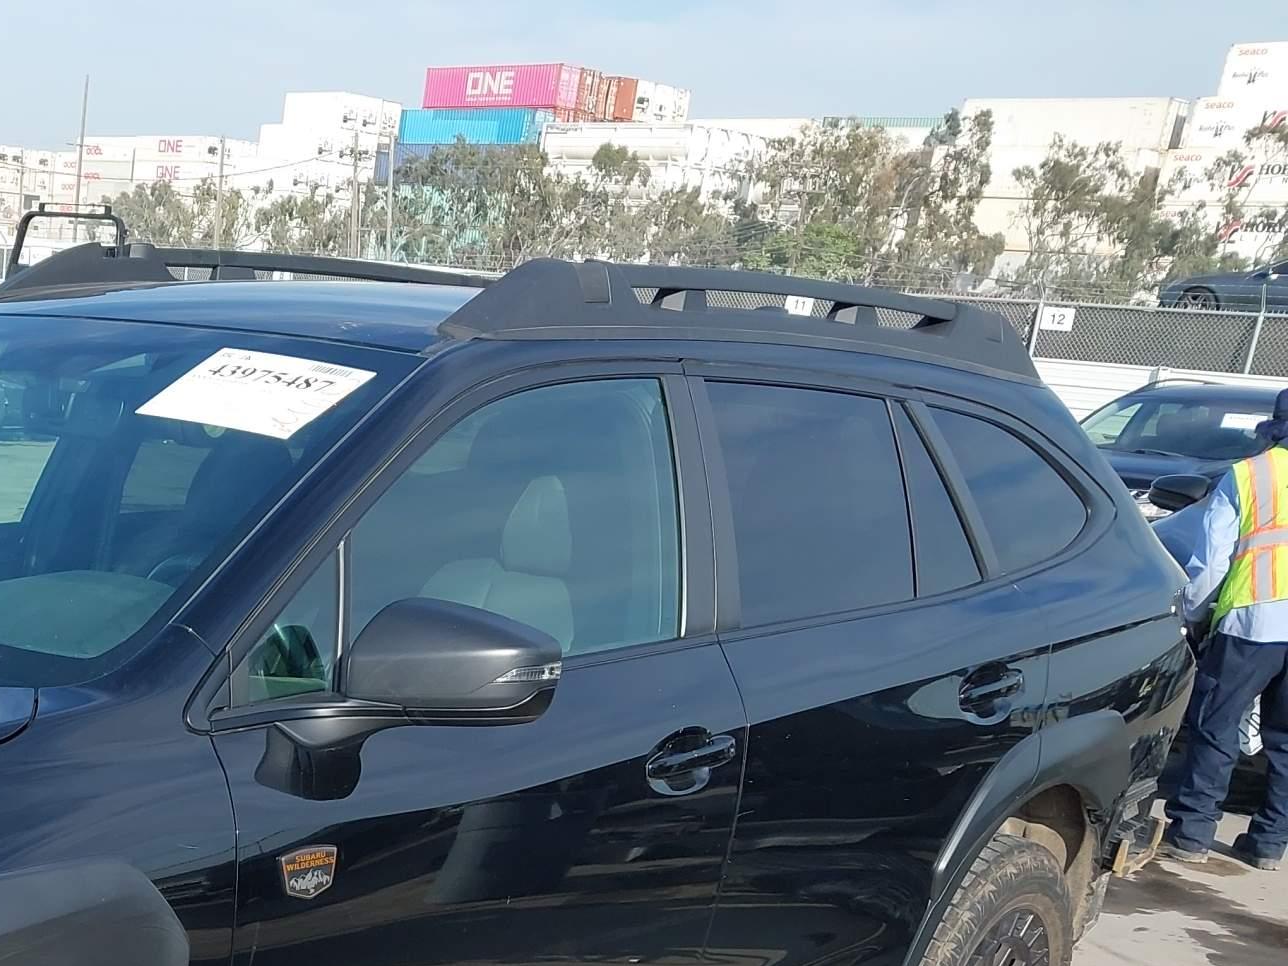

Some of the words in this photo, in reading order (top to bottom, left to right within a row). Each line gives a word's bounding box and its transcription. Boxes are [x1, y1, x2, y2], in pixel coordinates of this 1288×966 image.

[466, 71, 515, 95] ONE
[158, 139, 183, 153] ONE
[156, 165, 181, 179] ONE
[1050, 313, 1066, 325] 12
[208, 363, 337, 393] 43975487
[295, 850, 326, 863] SUBARU
[286, 857, 334, 872] WILDERNESS
